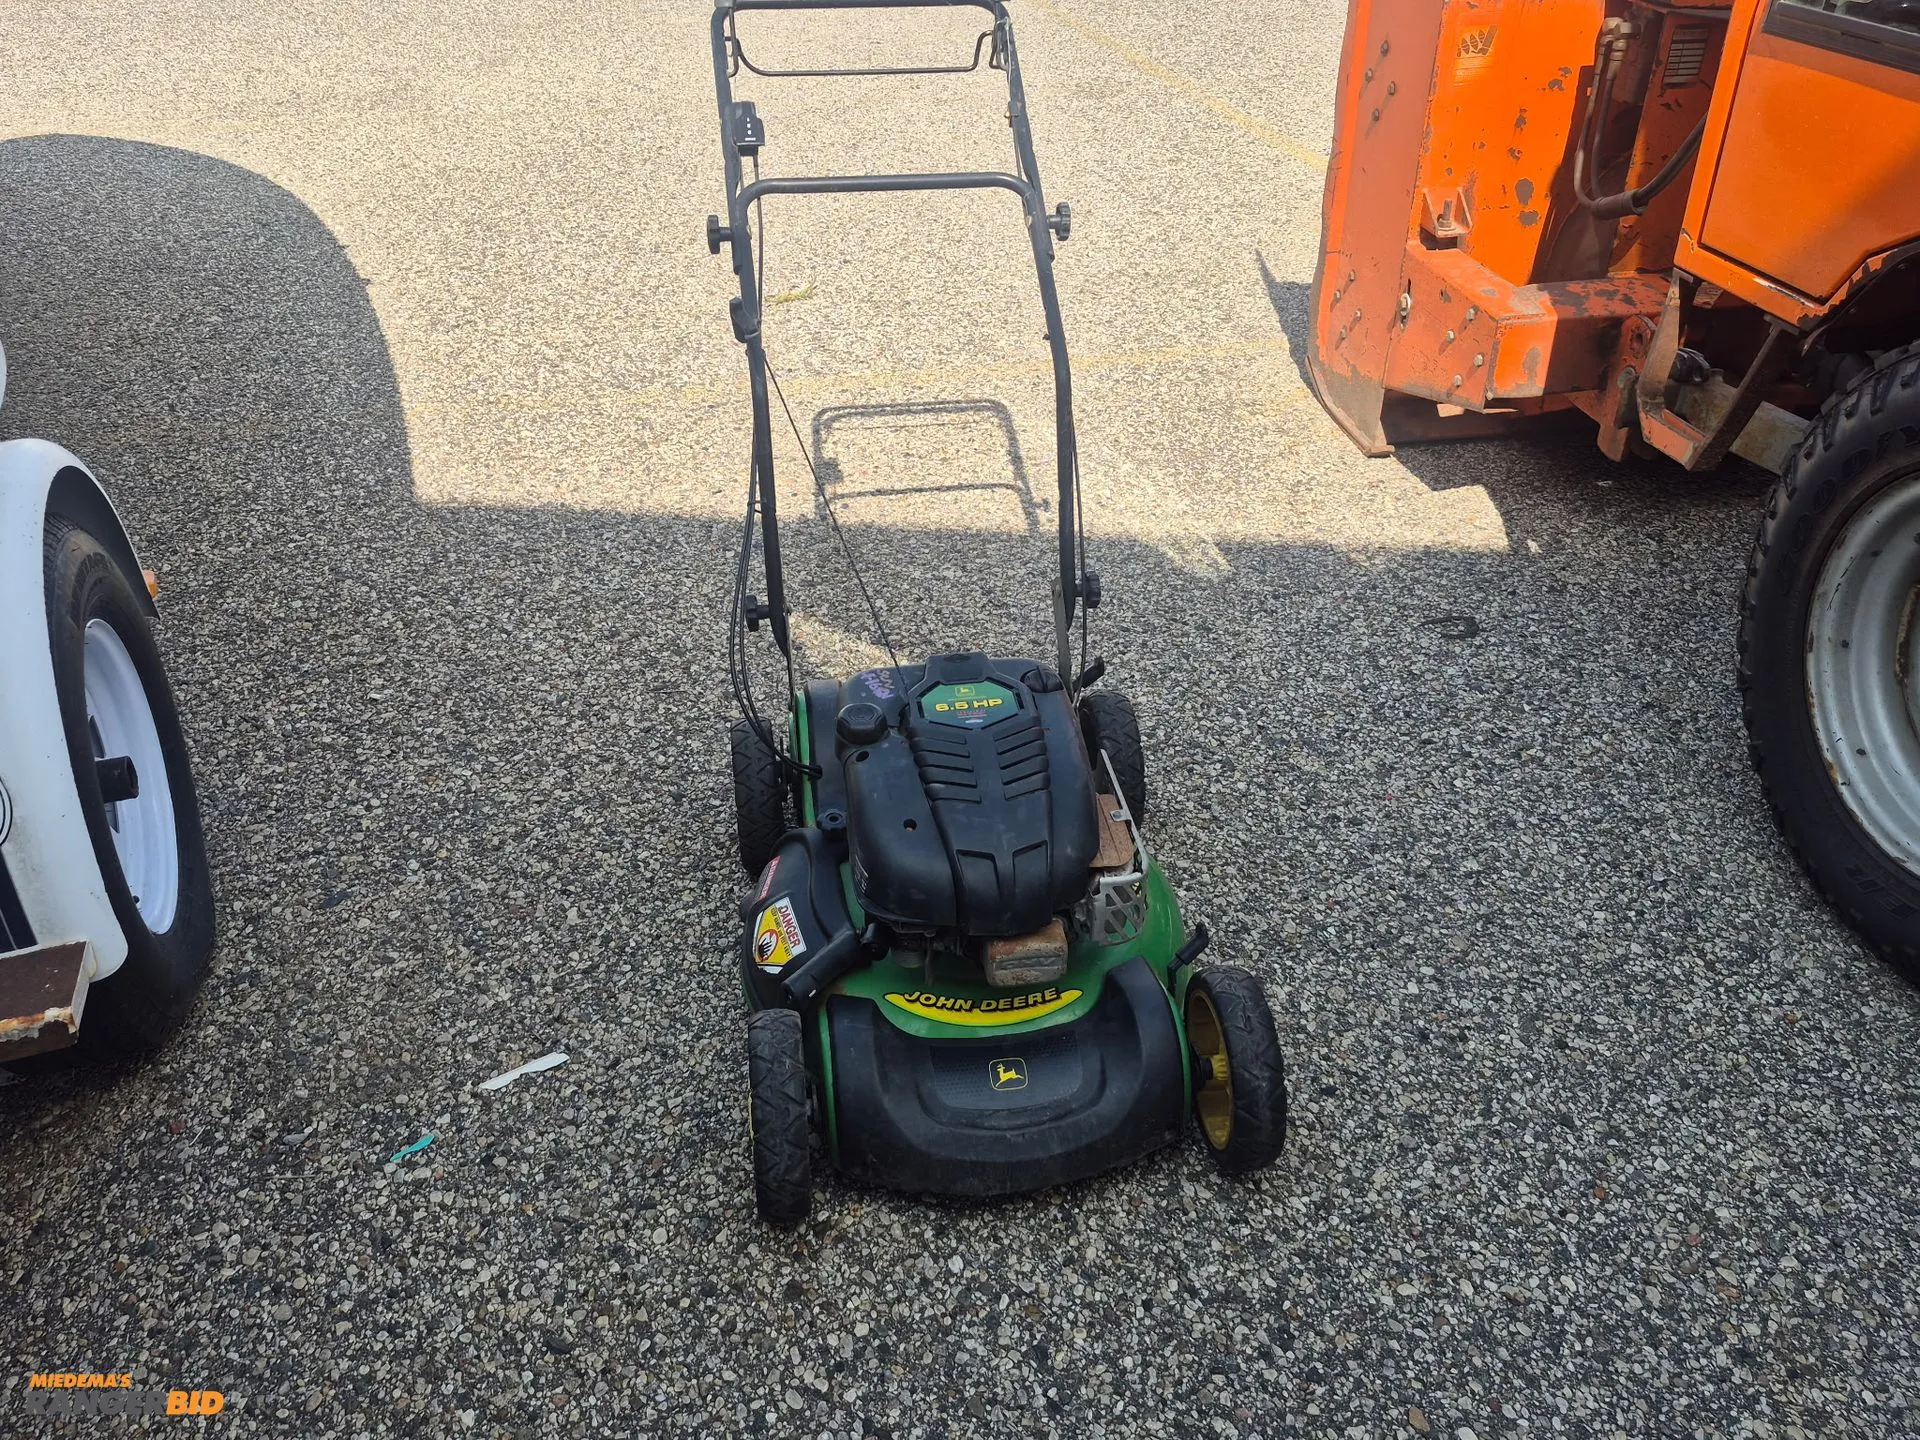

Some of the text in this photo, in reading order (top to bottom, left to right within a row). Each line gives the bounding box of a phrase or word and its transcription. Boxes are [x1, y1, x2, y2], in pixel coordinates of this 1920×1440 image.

[935, 698, 1004, 712] 6.5 HP
[778, 905, 801, 949] DANGER
[904, 987, 1059, 1011] JOHN DEERE
